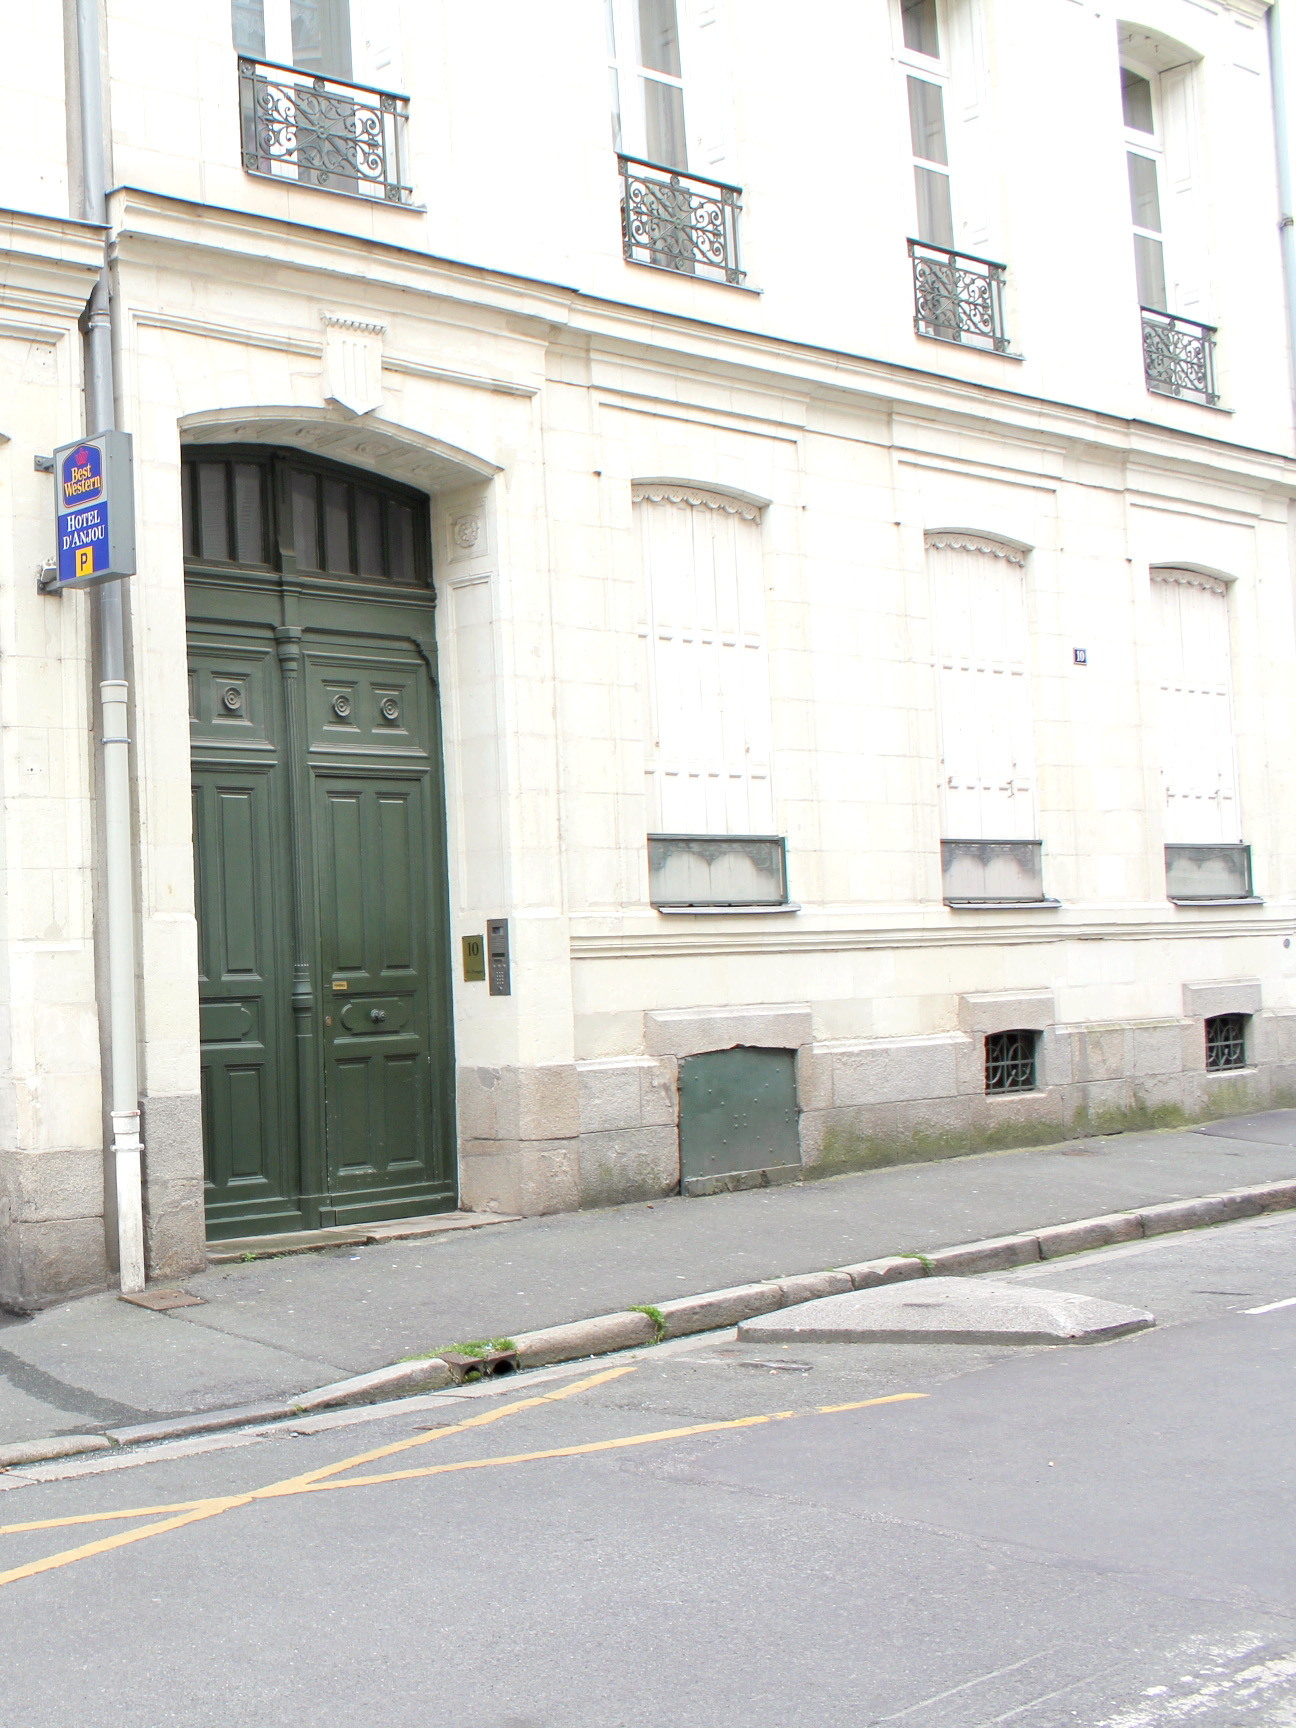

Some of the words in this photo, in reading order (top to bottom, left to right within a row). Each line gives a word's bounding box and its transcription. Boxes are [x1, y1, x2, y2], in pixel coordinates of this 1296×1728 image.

[70, 463, 92, 483] Best
[64, 475, 101, 498] Western
[67, 510, 100, 532] HOTEL
[62, 524, 105, 550] D'ANJOU
[80, 552, 88, 572] P
[1076, 650, 1085, 662] 10
[467, 941, 479, 957] 10
